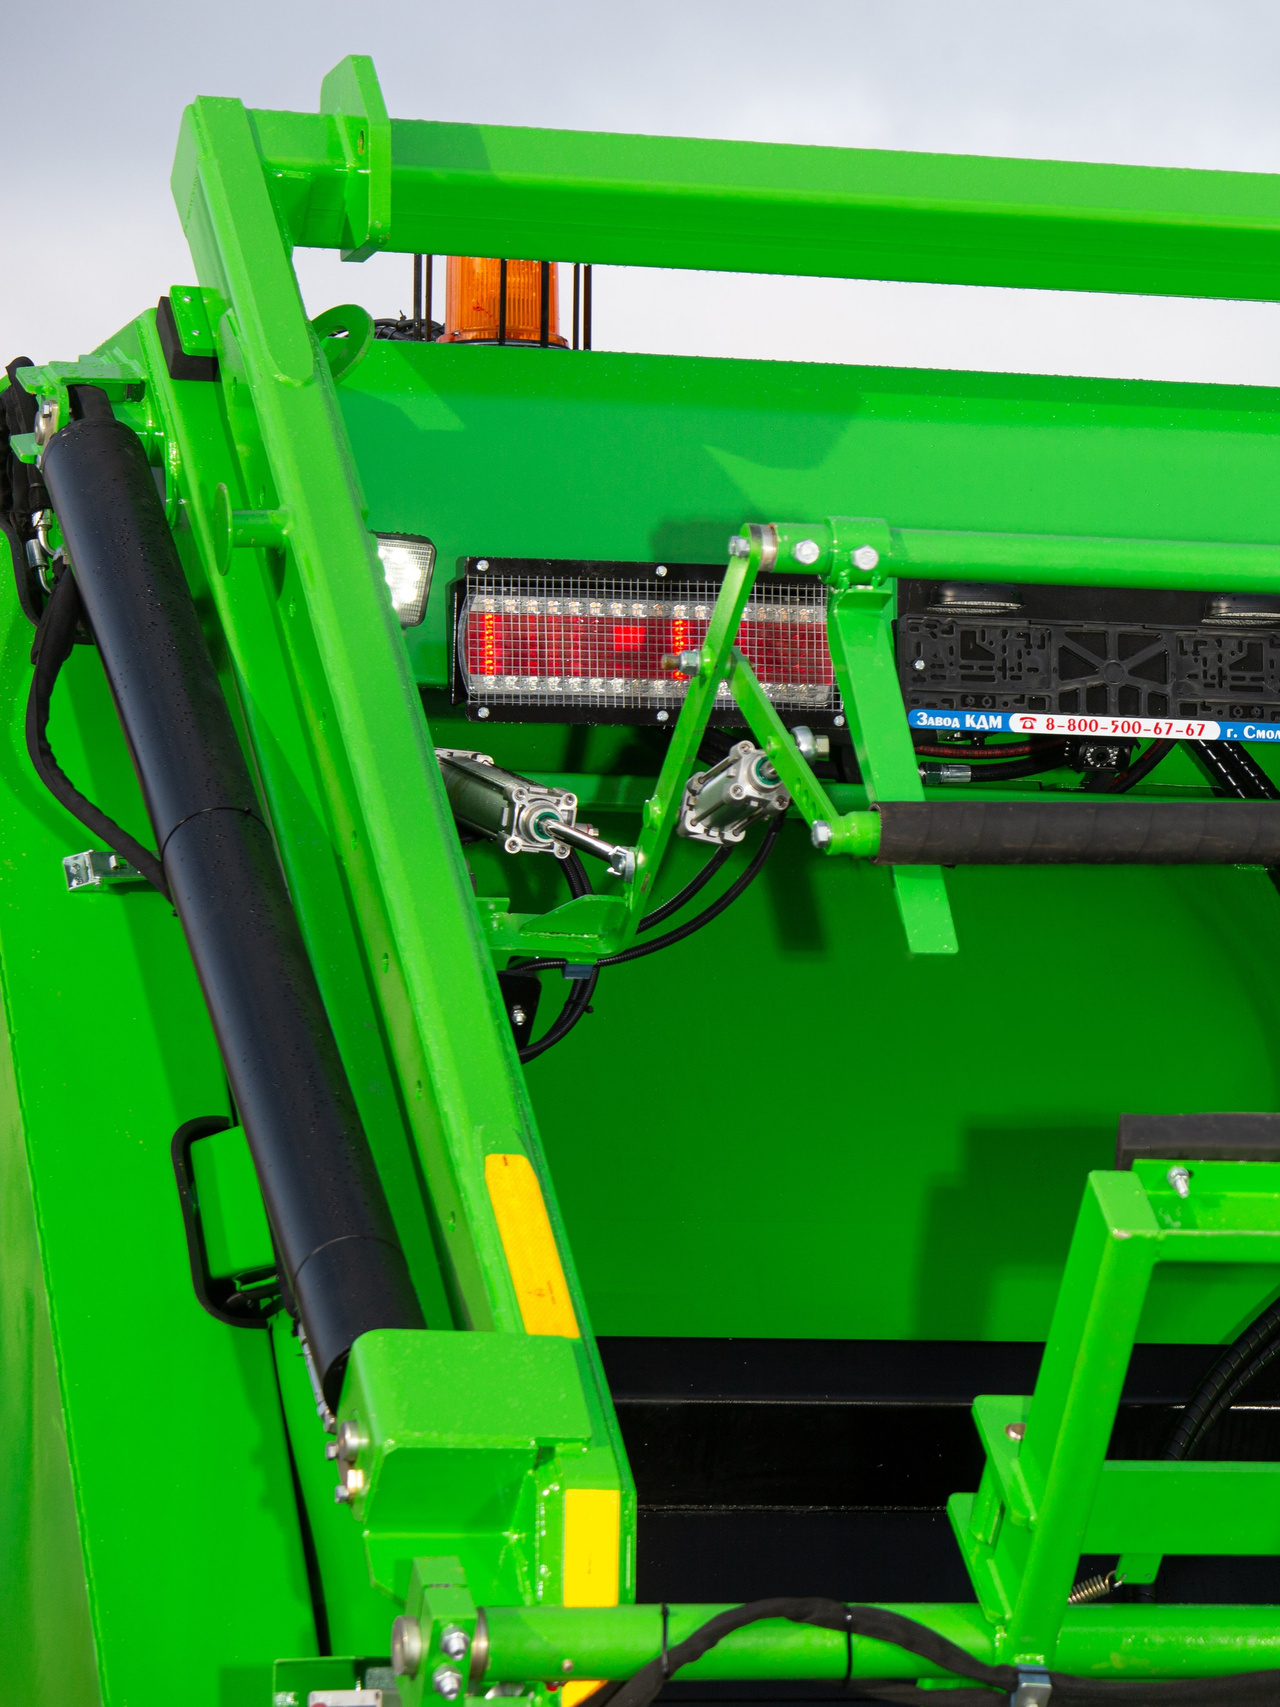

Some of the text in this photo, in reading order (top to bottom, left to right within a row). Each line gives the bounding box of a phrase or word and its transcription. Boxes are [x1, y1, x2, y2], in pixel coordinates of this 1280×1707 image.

[965, 714, 1003, 730] КДМ
[1045, 717, 1206, 737] 8-800-500-67-67
[1226, 728, 1238, 740] г.
